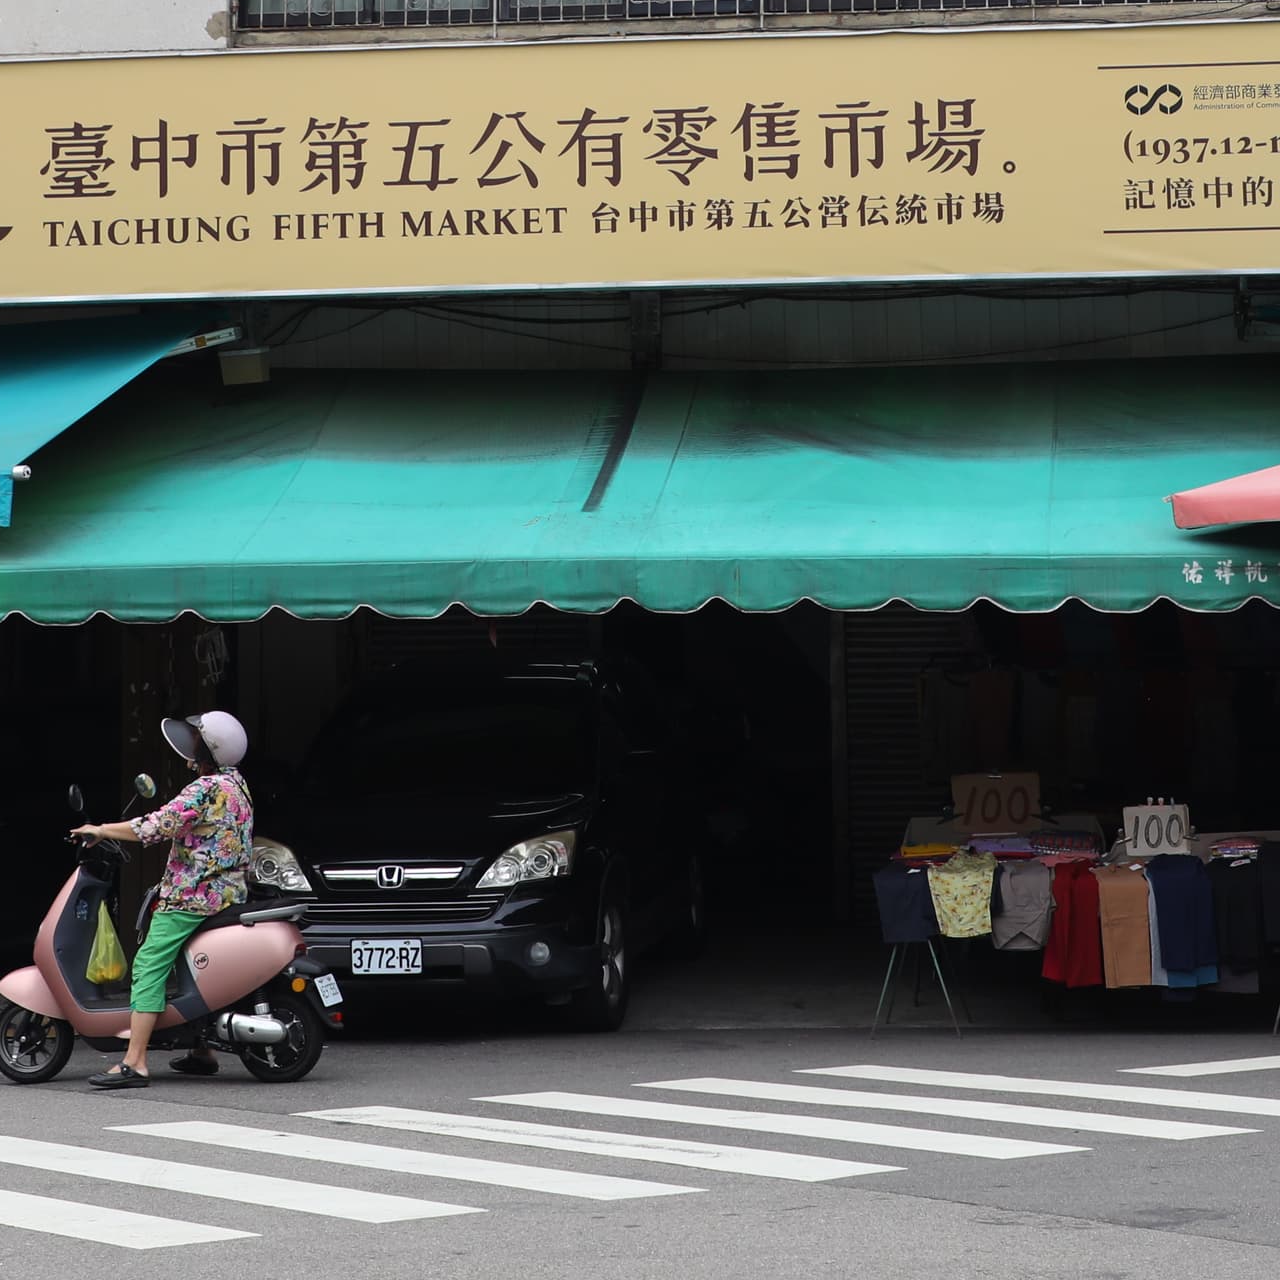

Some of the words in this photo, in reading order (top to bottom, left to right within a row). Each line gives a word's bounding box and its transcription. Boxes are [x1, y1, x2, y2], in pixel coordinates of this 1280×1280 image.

[42, 215, 252, 248] TAICHUNG
[273, 211, 386, 241] FIFTH
[401, 206, 568, 238] MARKET
[964, 786, 1031, 826] 100
[1132, 814, 1184, 849] 100
